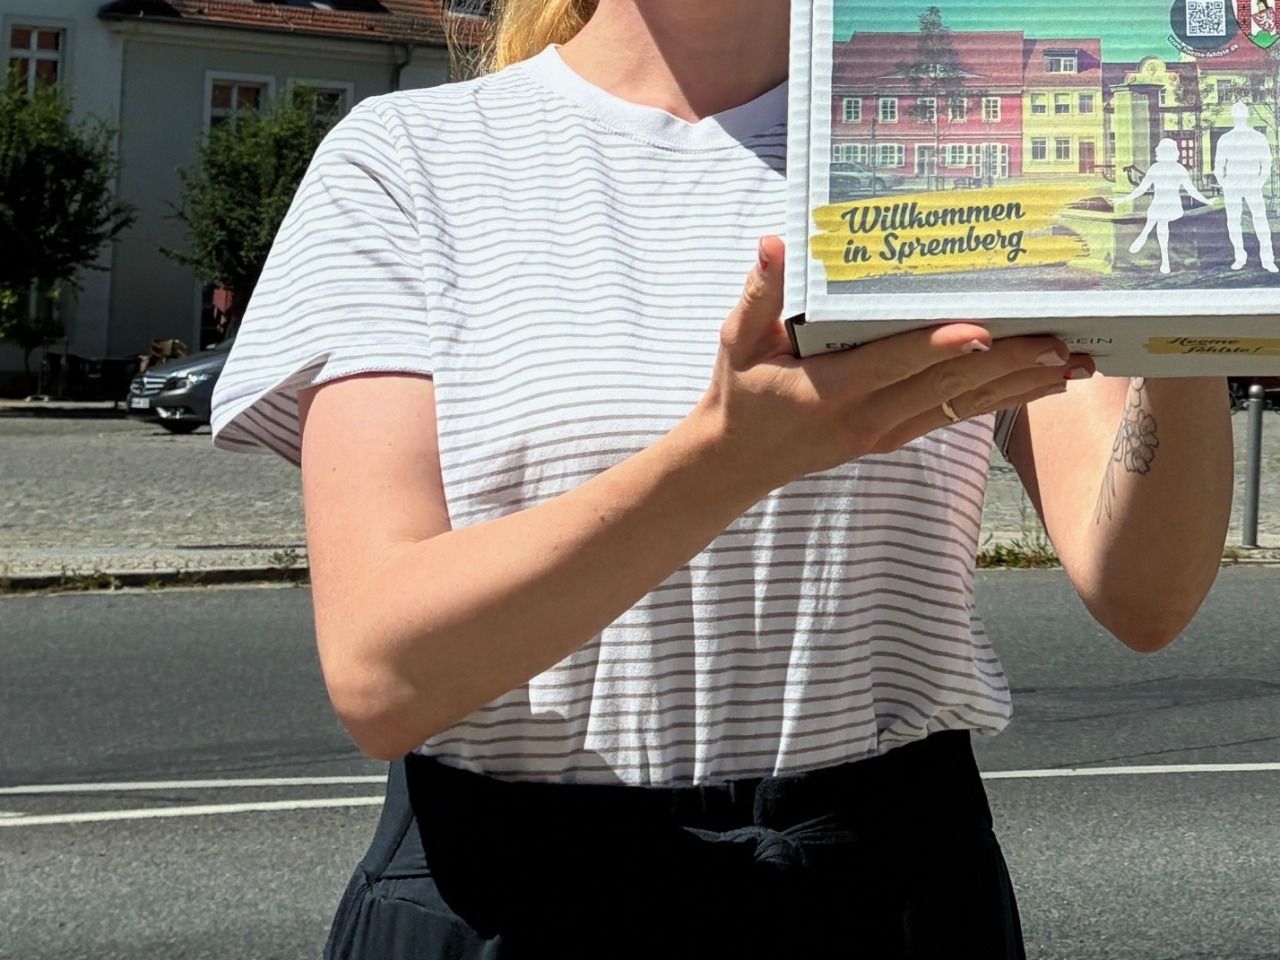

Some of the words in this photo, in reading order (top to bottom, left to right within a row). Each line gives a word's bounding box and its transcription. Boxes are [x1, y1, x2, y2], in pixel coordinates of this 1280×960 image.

[841, 202, 1025, 234] Willkommen
[843, 239, 871, 264] in
[879, 227, 1027, 263] Spremberg
